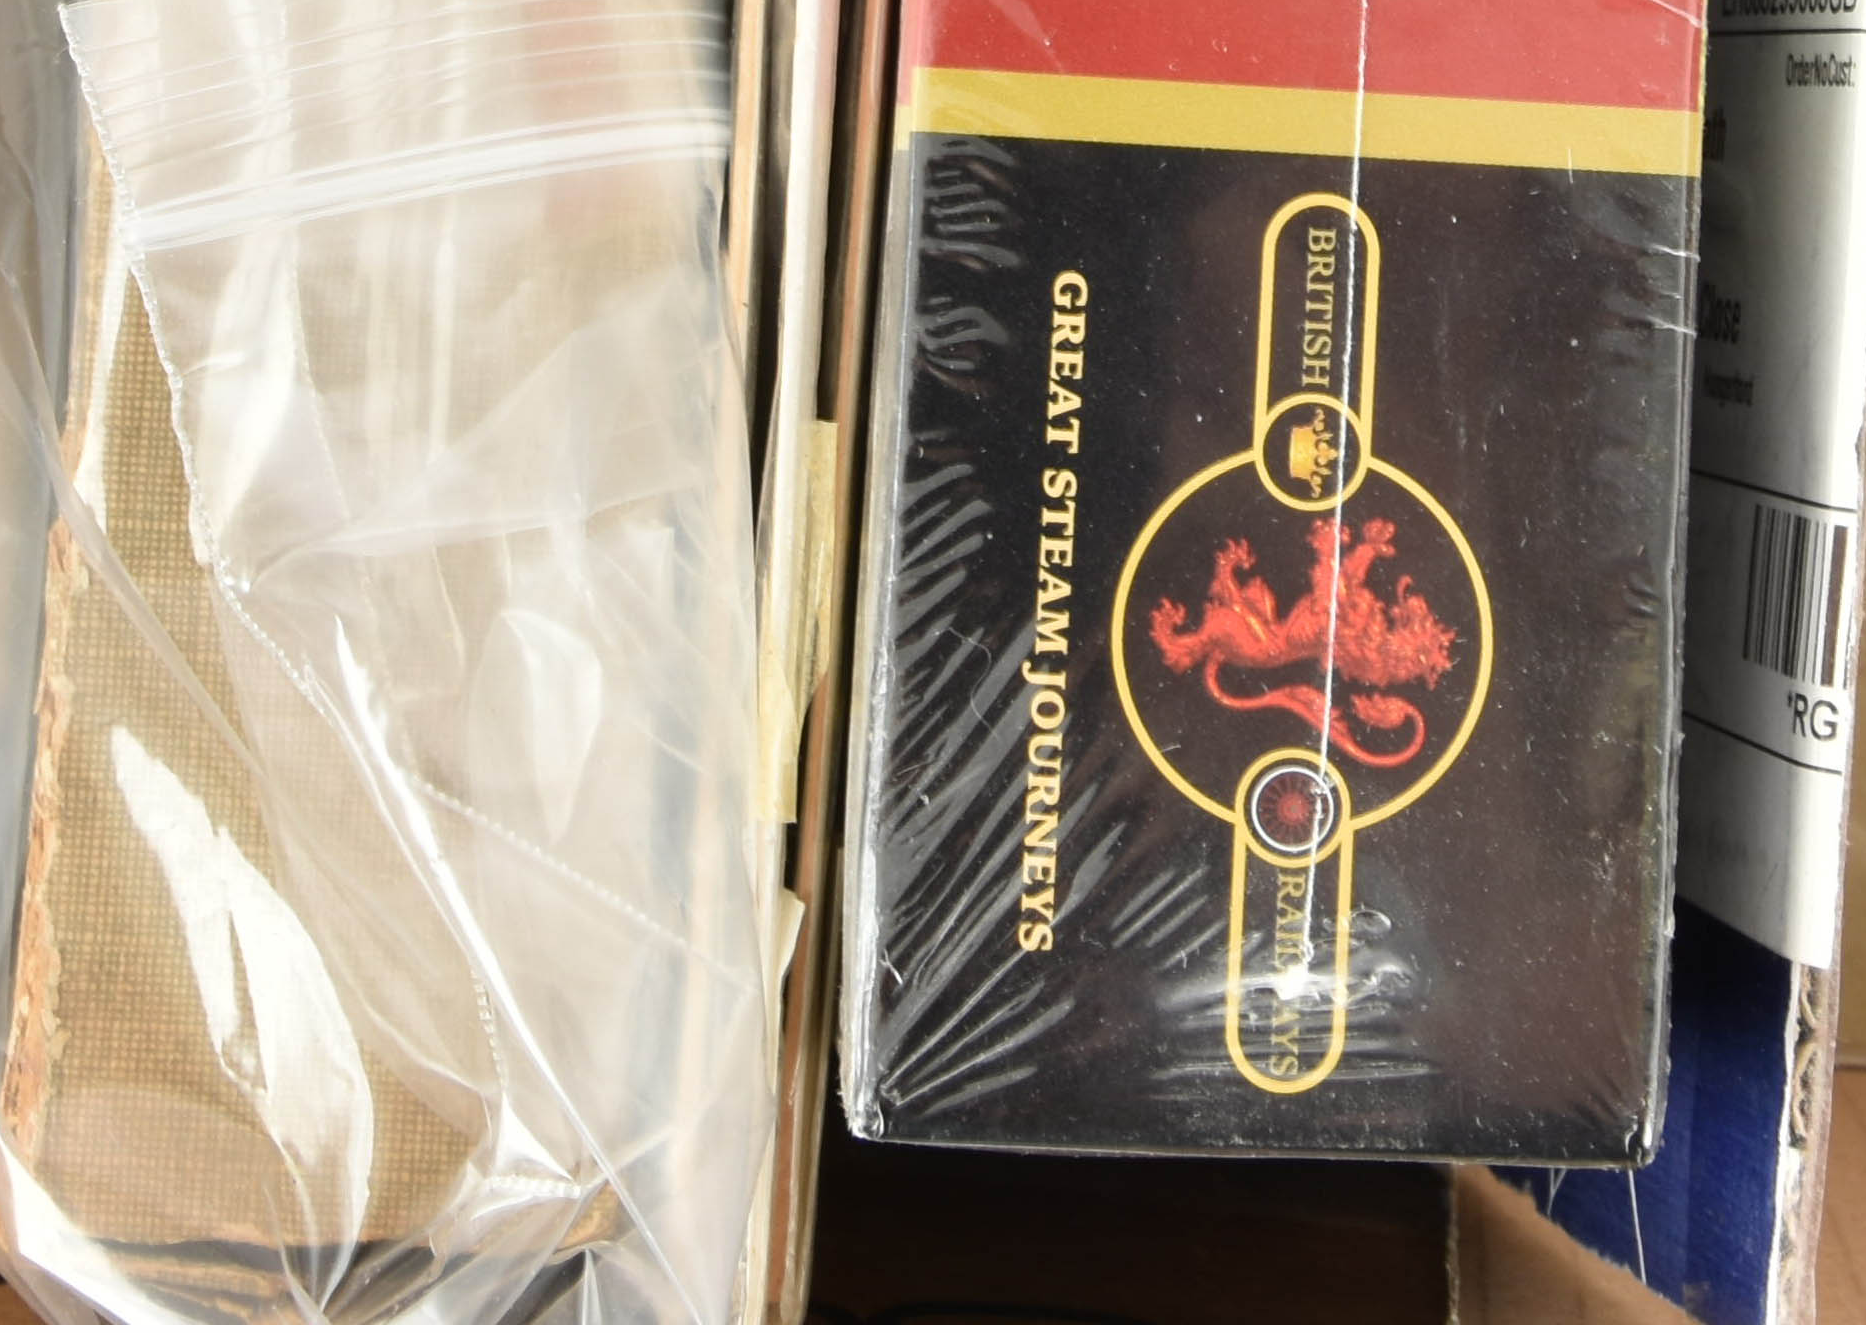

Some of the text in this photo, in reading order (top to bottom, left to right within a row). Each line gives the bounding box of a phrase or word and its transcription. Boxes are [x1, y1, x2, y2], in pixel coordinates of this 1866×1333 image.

[1298, 226, 1339, 392] BRITISH
[1015, 269, 1090, 955] GREAT STEAM JOURNEYS
[1268, 870, 1308, 1082] RAILAYS
